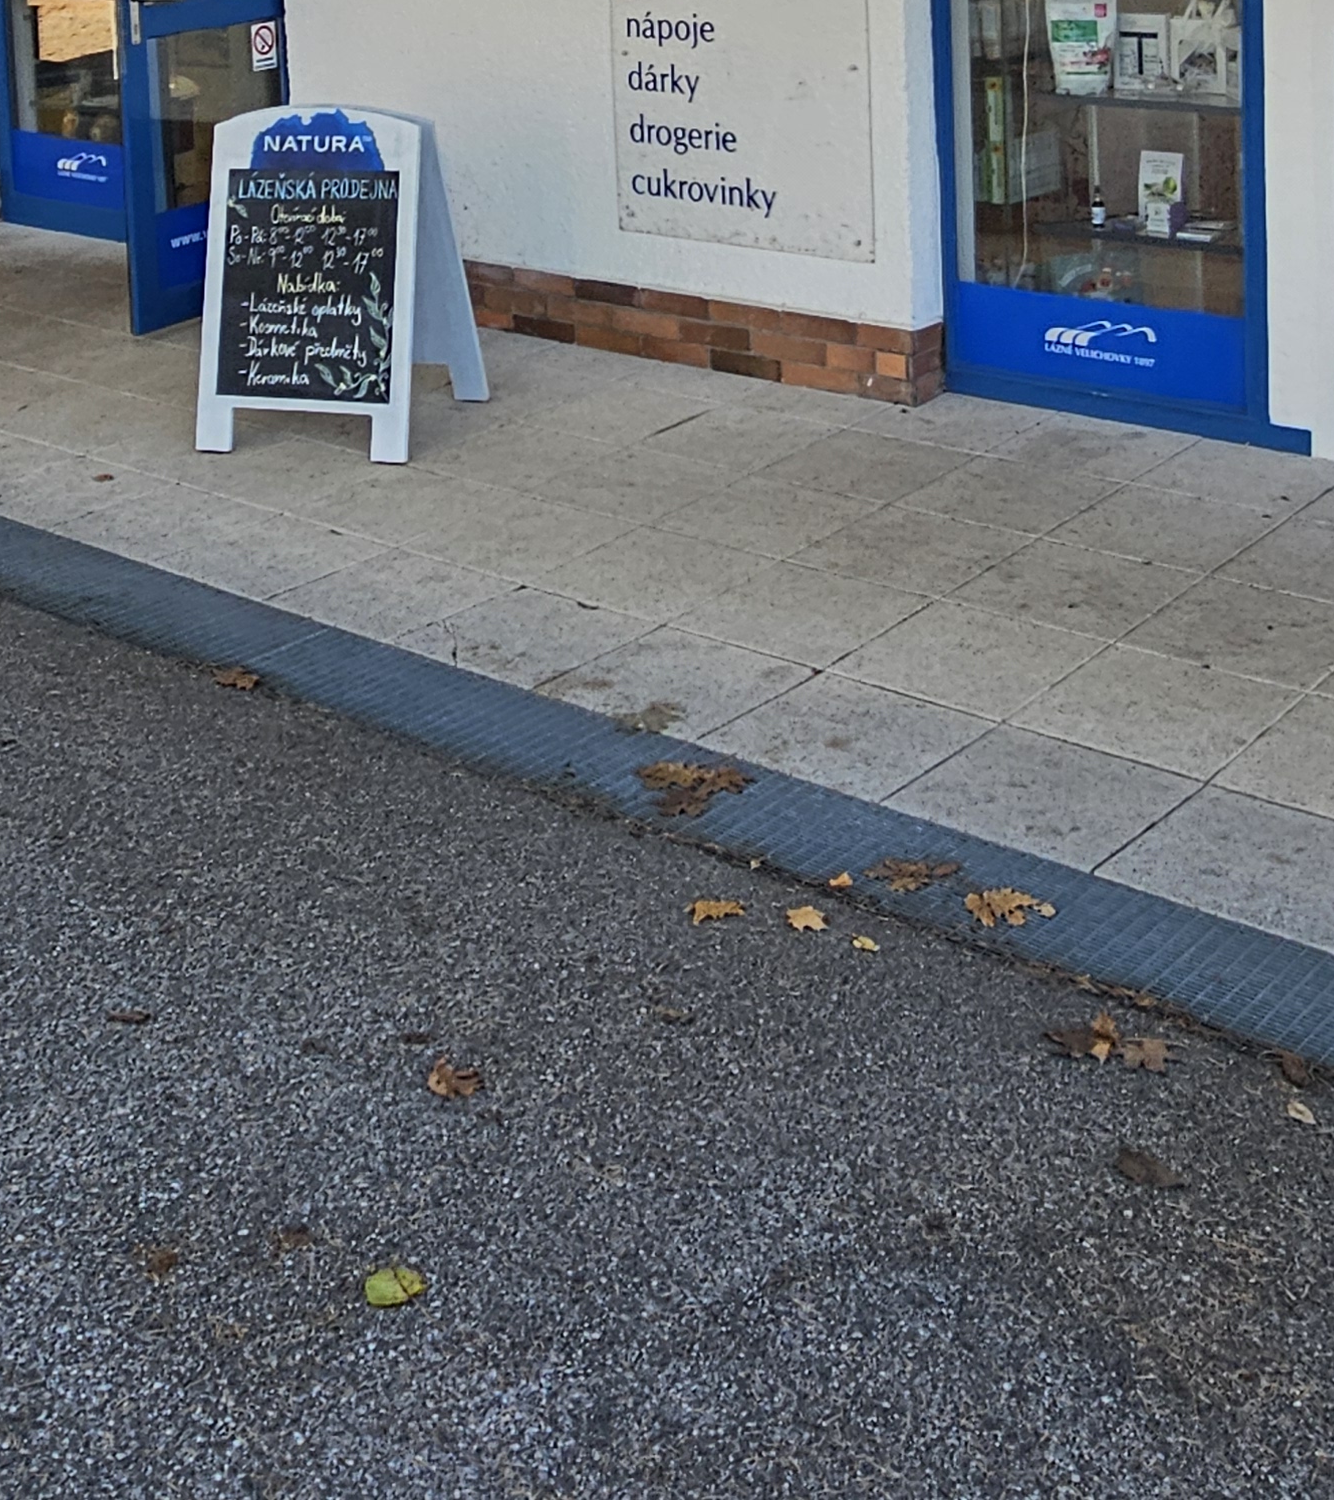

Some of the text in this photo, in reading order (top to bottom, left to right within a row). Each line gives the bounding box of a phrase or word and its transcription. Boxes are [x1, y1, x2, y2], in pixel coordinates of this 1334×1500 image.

[625, 11, 716, 49] nápoje
[627, 60, 699, 103] dárky
[263, 135, 365, 153] NATURA
[629, 113, 737, 155] drogerie
[238, 172, 398, 200] LÁZEŇSKÁ PRODEJNA
[631, 168, 777, 219] cukrovinky
